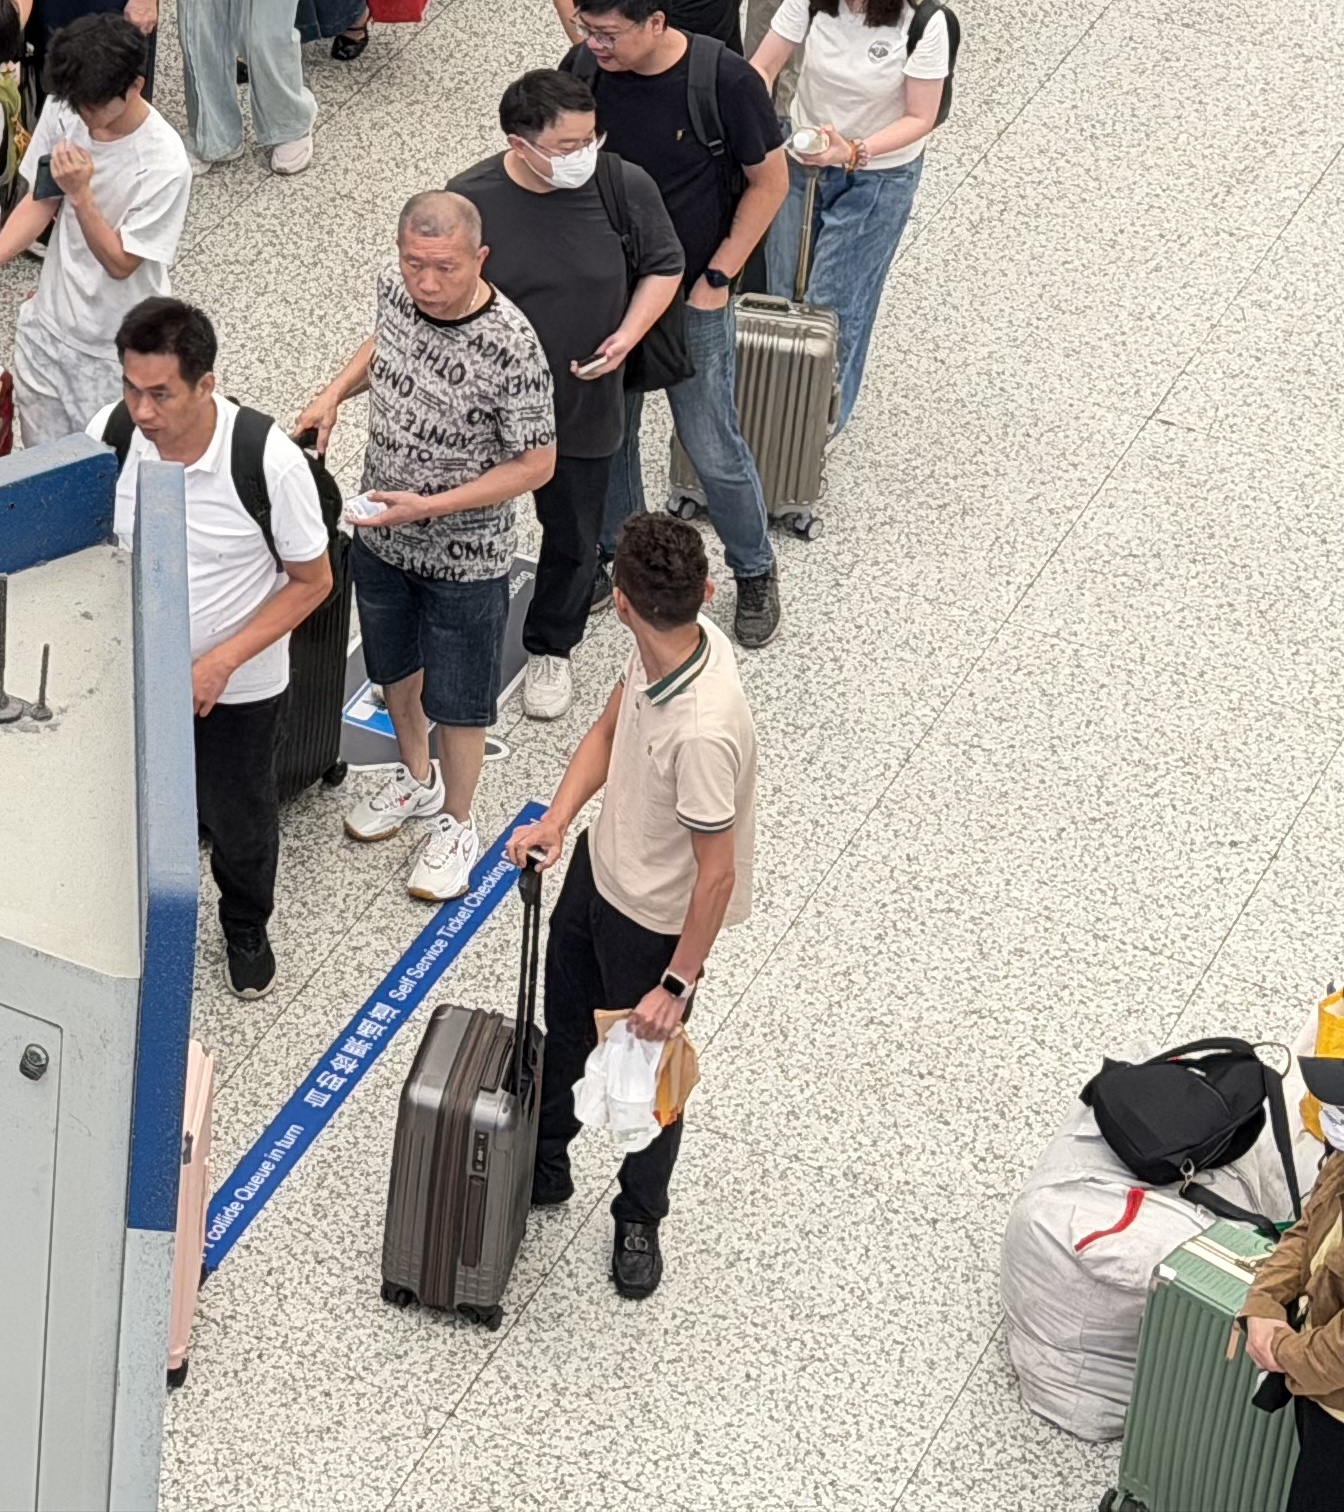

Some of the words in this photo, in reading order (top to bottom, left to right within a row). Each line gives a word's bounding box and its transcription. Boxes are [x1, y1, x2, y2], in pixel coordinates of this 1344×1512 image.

[389, 976, 418, 1001] Self
[406, 938, 449, 979] Service
[436, 905, 474, 939] Ticket
[464, 859, 516, 908] Checking
[303, 1001, 402, 1108] 自助检票通道
[263, 1148, 287, 1162] in
[274, 1124, 305, 1149] turn
[234, 1159, 276, 1201] Queue
[206, 1200, 245, 1241] collide
